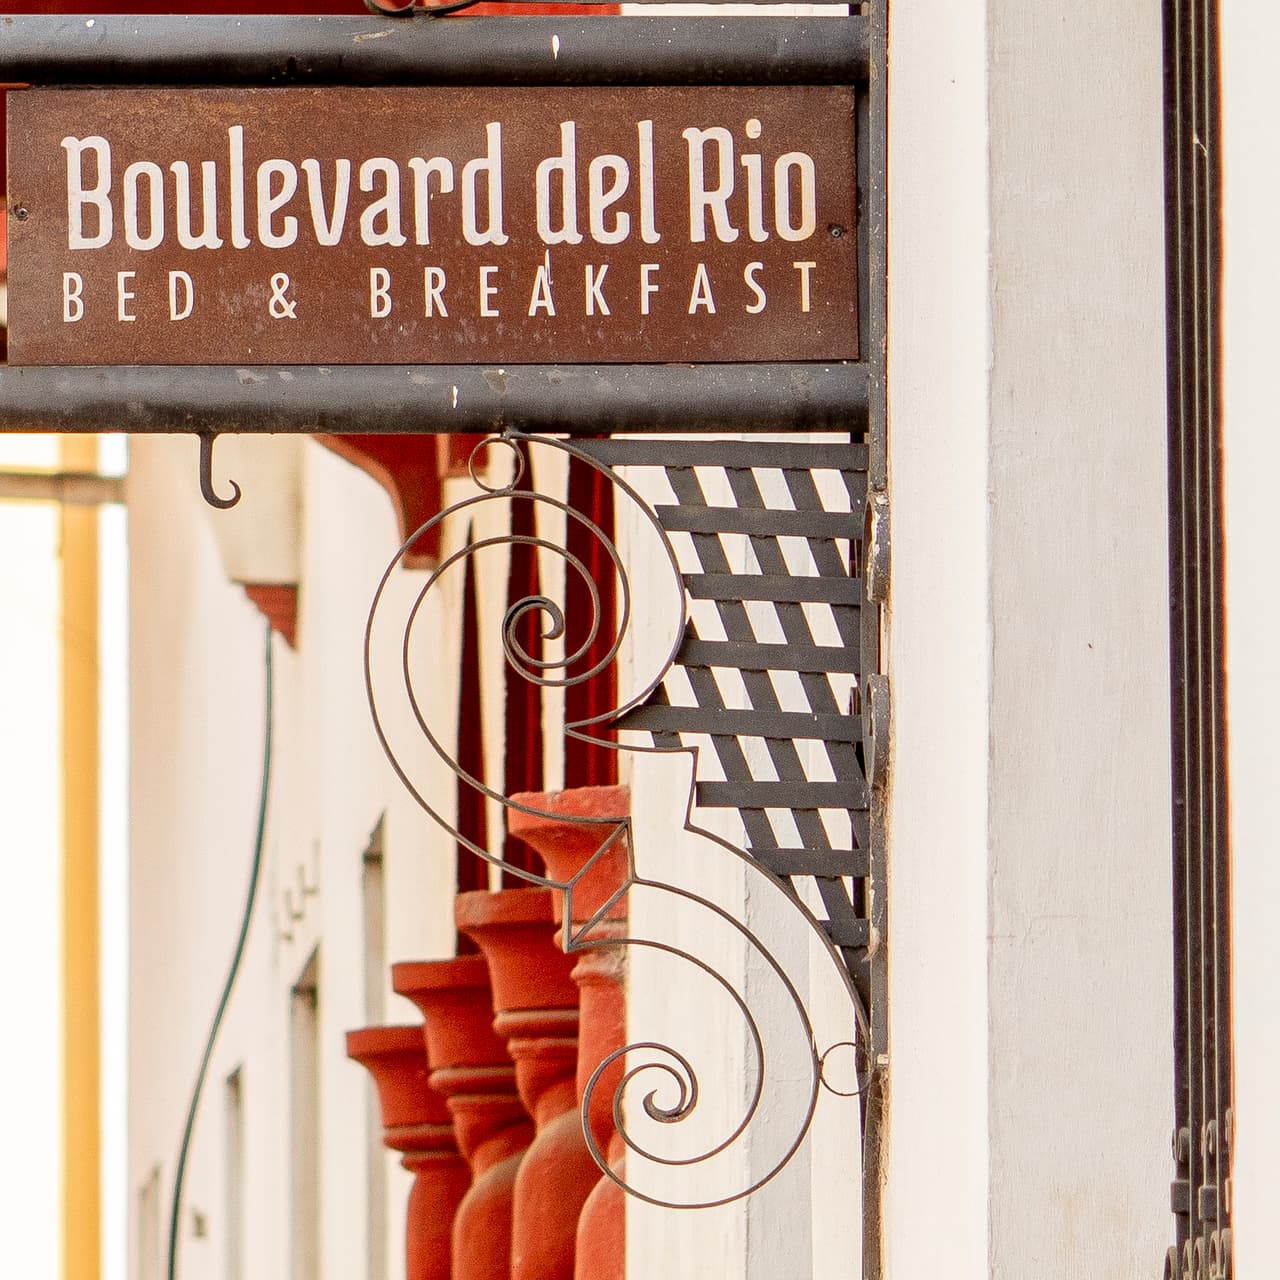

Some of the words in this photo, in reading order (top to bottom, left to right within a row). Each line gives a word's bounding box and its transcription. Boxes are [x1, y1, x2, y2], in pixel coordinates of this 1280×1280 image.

[61, 121, 509, 251] Boulevard
[535, 120, 662, 245] del
[682, 118, 817, 243] Rio
[63, 271, 195, 322] BED
[268, 272, 298, 320] &
[370, 261, 817, 318] BREAKFAST
